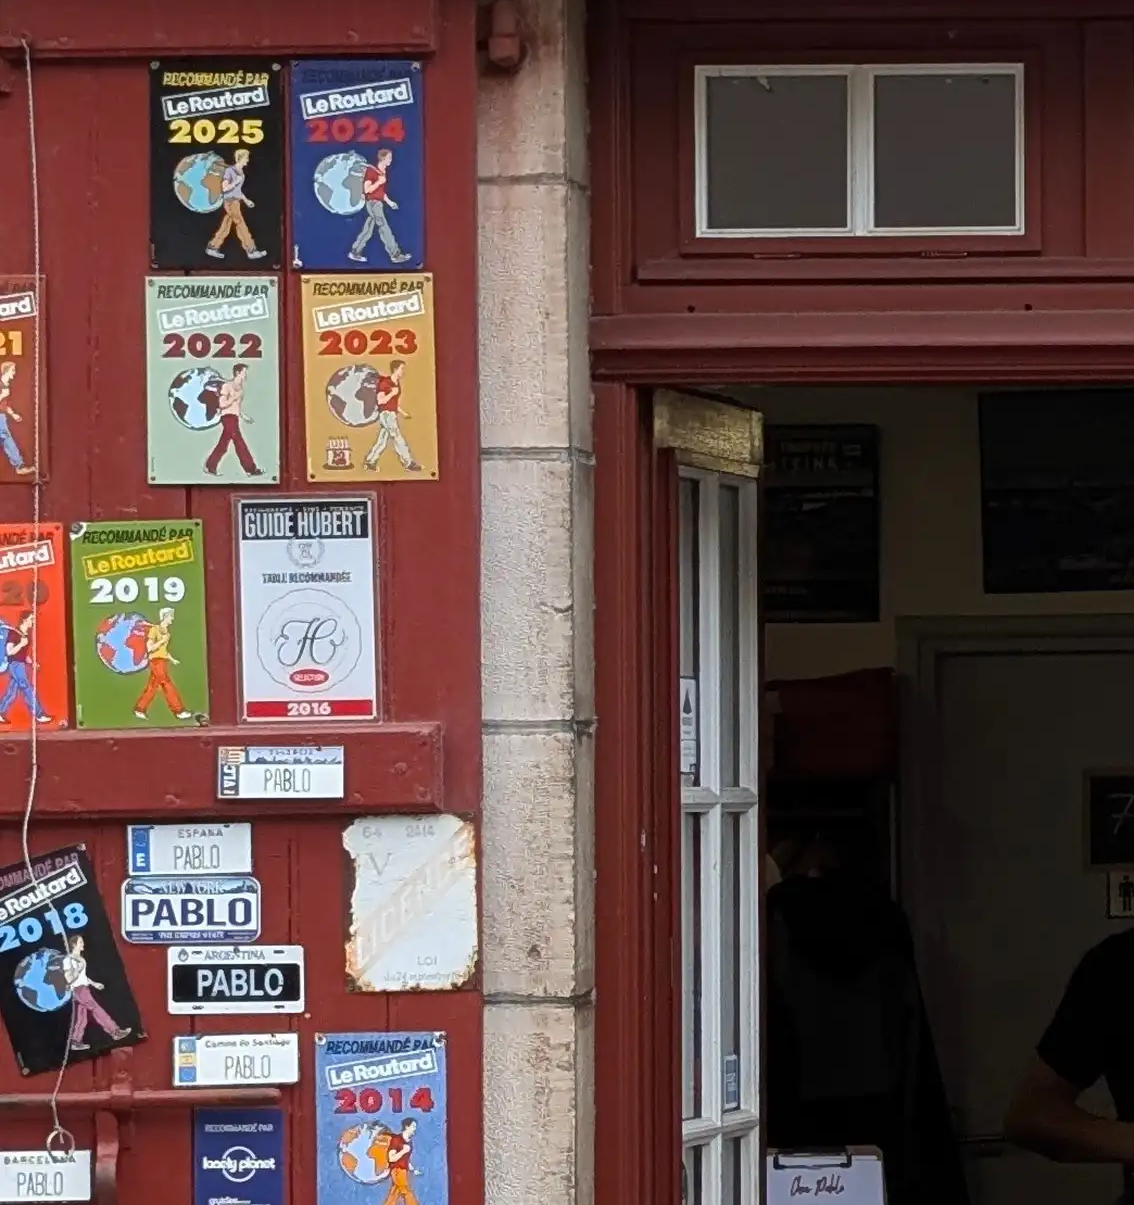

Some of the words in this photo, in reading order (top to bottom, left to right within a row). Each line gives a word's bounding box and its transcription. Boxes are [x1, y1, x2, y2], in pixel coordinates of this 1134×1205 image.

[168, 119, 264, 145] 2025
[307, 119, 405, 144] 2024
[157, 281, 242, 299] RECOMMANDÉ
[244, 284, 269, 297] PAR
[312, 279, 398, 296] RECOMMANDÉ
[399, 282, 425, 294] PAR
[162, 334, 262, 359] 2022
[318, 330, 417, 356] 2023
[82, 526, 167, 545] RECOMMANDÉ
[168, 527, 194, 543] PAR
[245, 512, 294, 538] GUIDE
[297, 511, 365, 538] HUBERT
[89, 577, 185, 604] 2019
[287, 701, 332, 716] 2016
[264, 767, 311, 794] PABLO
[136, 852, 147, 868] E
[173, 844, 221, 871] PABLO
[132, 898, 253, 927] PABLO
[0, 902, 89, 953] 2018
[417, 955, 438, 967] LOI
[196, 967, 285, 998] PABLO
[325, 1037, 410, 1055] RECOMMANDÉ
[224, 1053, 271, 1080] PABLO
[334, 1087, 435, 1115] 2014
[17, 1171, 64, 1197] PABLO
